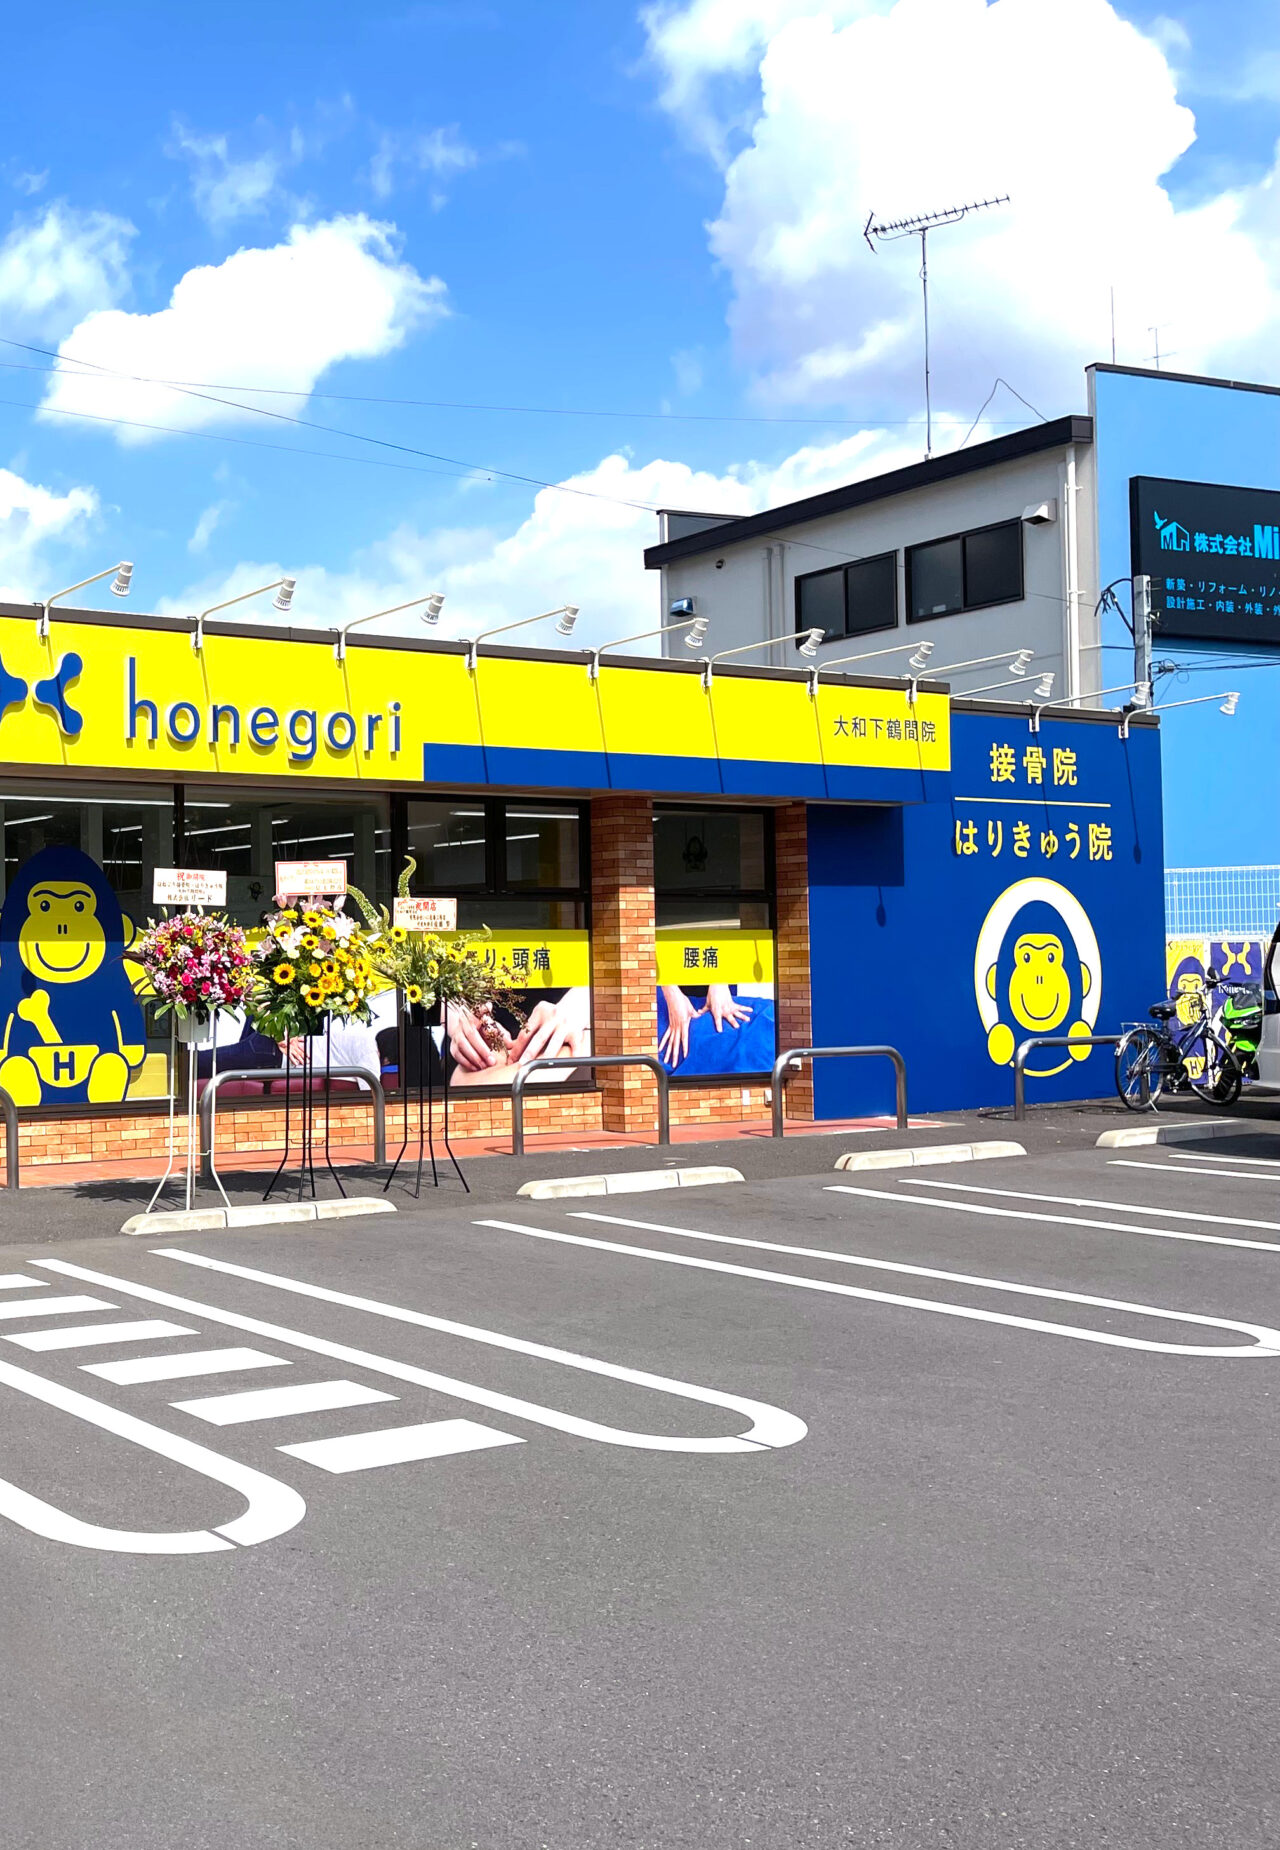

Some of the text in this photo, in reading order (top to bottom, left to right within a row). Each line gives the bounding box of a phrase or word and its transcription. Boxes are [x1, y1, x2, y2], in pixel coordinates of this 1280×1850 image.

[1165, 578, 1280, 598] 新築・リフォーム・リノ
[126, 656, 402, 761] honegori
[833, 715, 937, 742] 大和下鶴間院
[989, 743, 1078, 785] 接骨院
[954, 819, 1113, 861] はりきゅう院
[478, 946, 551, 970] り・頭痛
[683, 945, 719, 968] 腰痛
[53, 1050, 75, 1082] H
